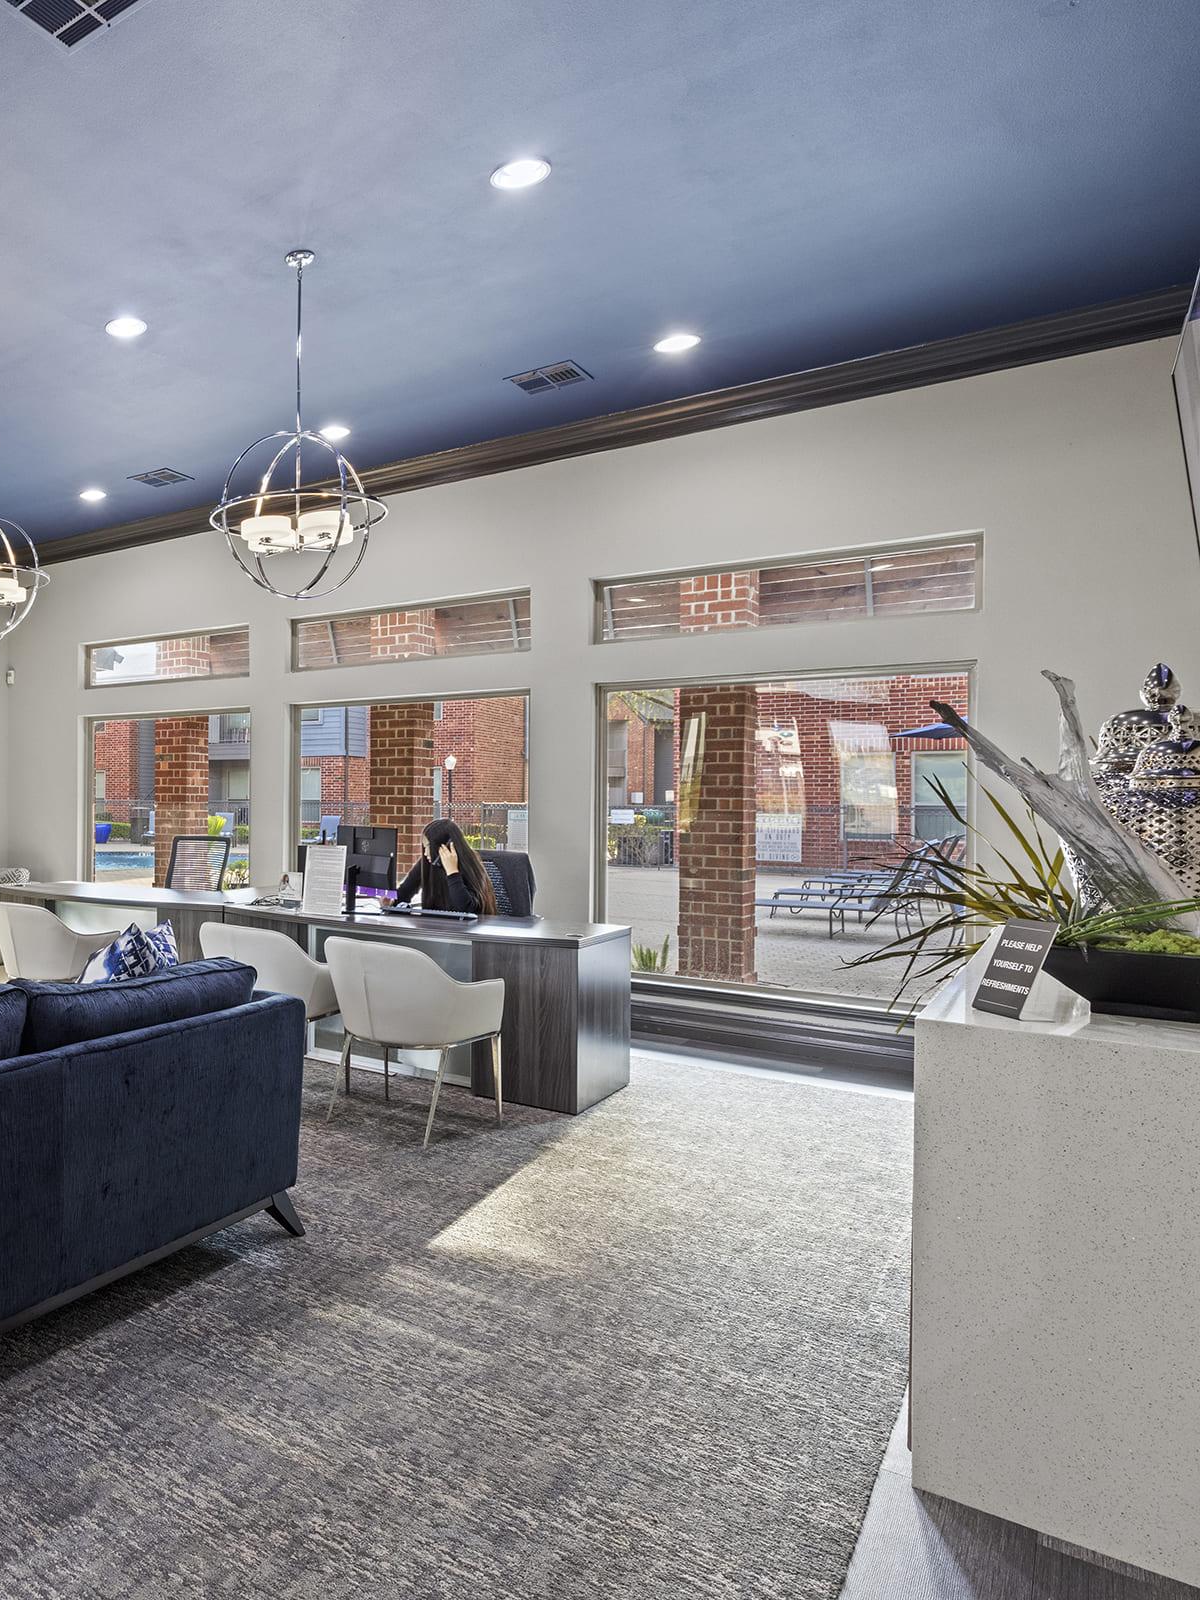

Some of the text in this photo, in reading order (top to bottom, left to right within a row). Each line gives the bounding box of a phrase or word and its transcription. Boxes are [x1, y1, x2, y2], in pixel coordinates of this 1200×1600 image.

[769, 853, 790, 861] DIVING
[1000, 938, 1043, 952] PLEASE HELP
[992, 958, 1034, 974] YOURSELF TO
[981, 978, 1030, 995] REFRESHMENTS
